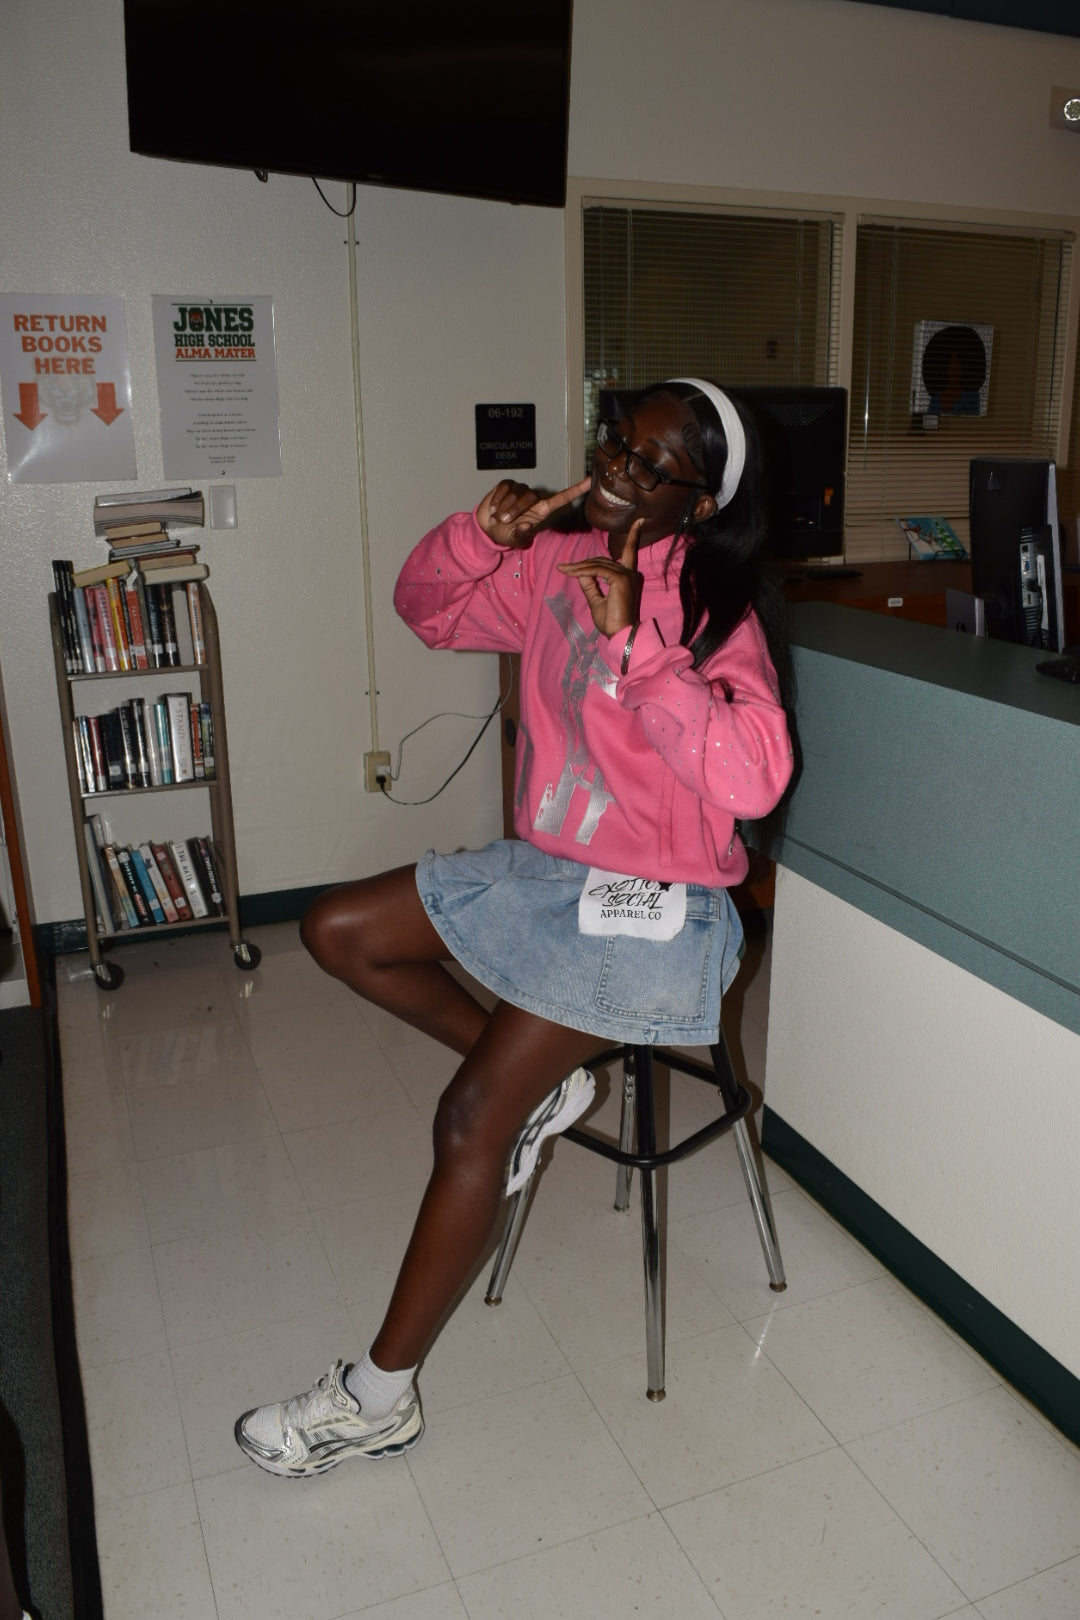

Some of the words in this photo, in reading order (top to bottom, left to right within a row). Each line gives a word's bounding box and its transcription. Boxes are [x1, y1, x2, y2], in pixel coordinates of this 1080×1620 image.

[13, 314, 107, 332] RETURN
[173, 307, 254, 332] JONES
[21, 336, 103, 353] BOOKS
[174, 333, 205, 348] HIGH
[208, 333, 256, 348] SCHOOL
[175, 348, 211, 359] ALMA
[214, 348, 256, 359] MATER
[34, 357, 96, 375] HERE
[488, 407, 524, 418] 06-192
[480, 441, 533, 450] CIRCULATION
[495, 451, 518, 460] DESK
[600, 909, 646, 920] APPAREL
[648, 911, 662, 920] CO
